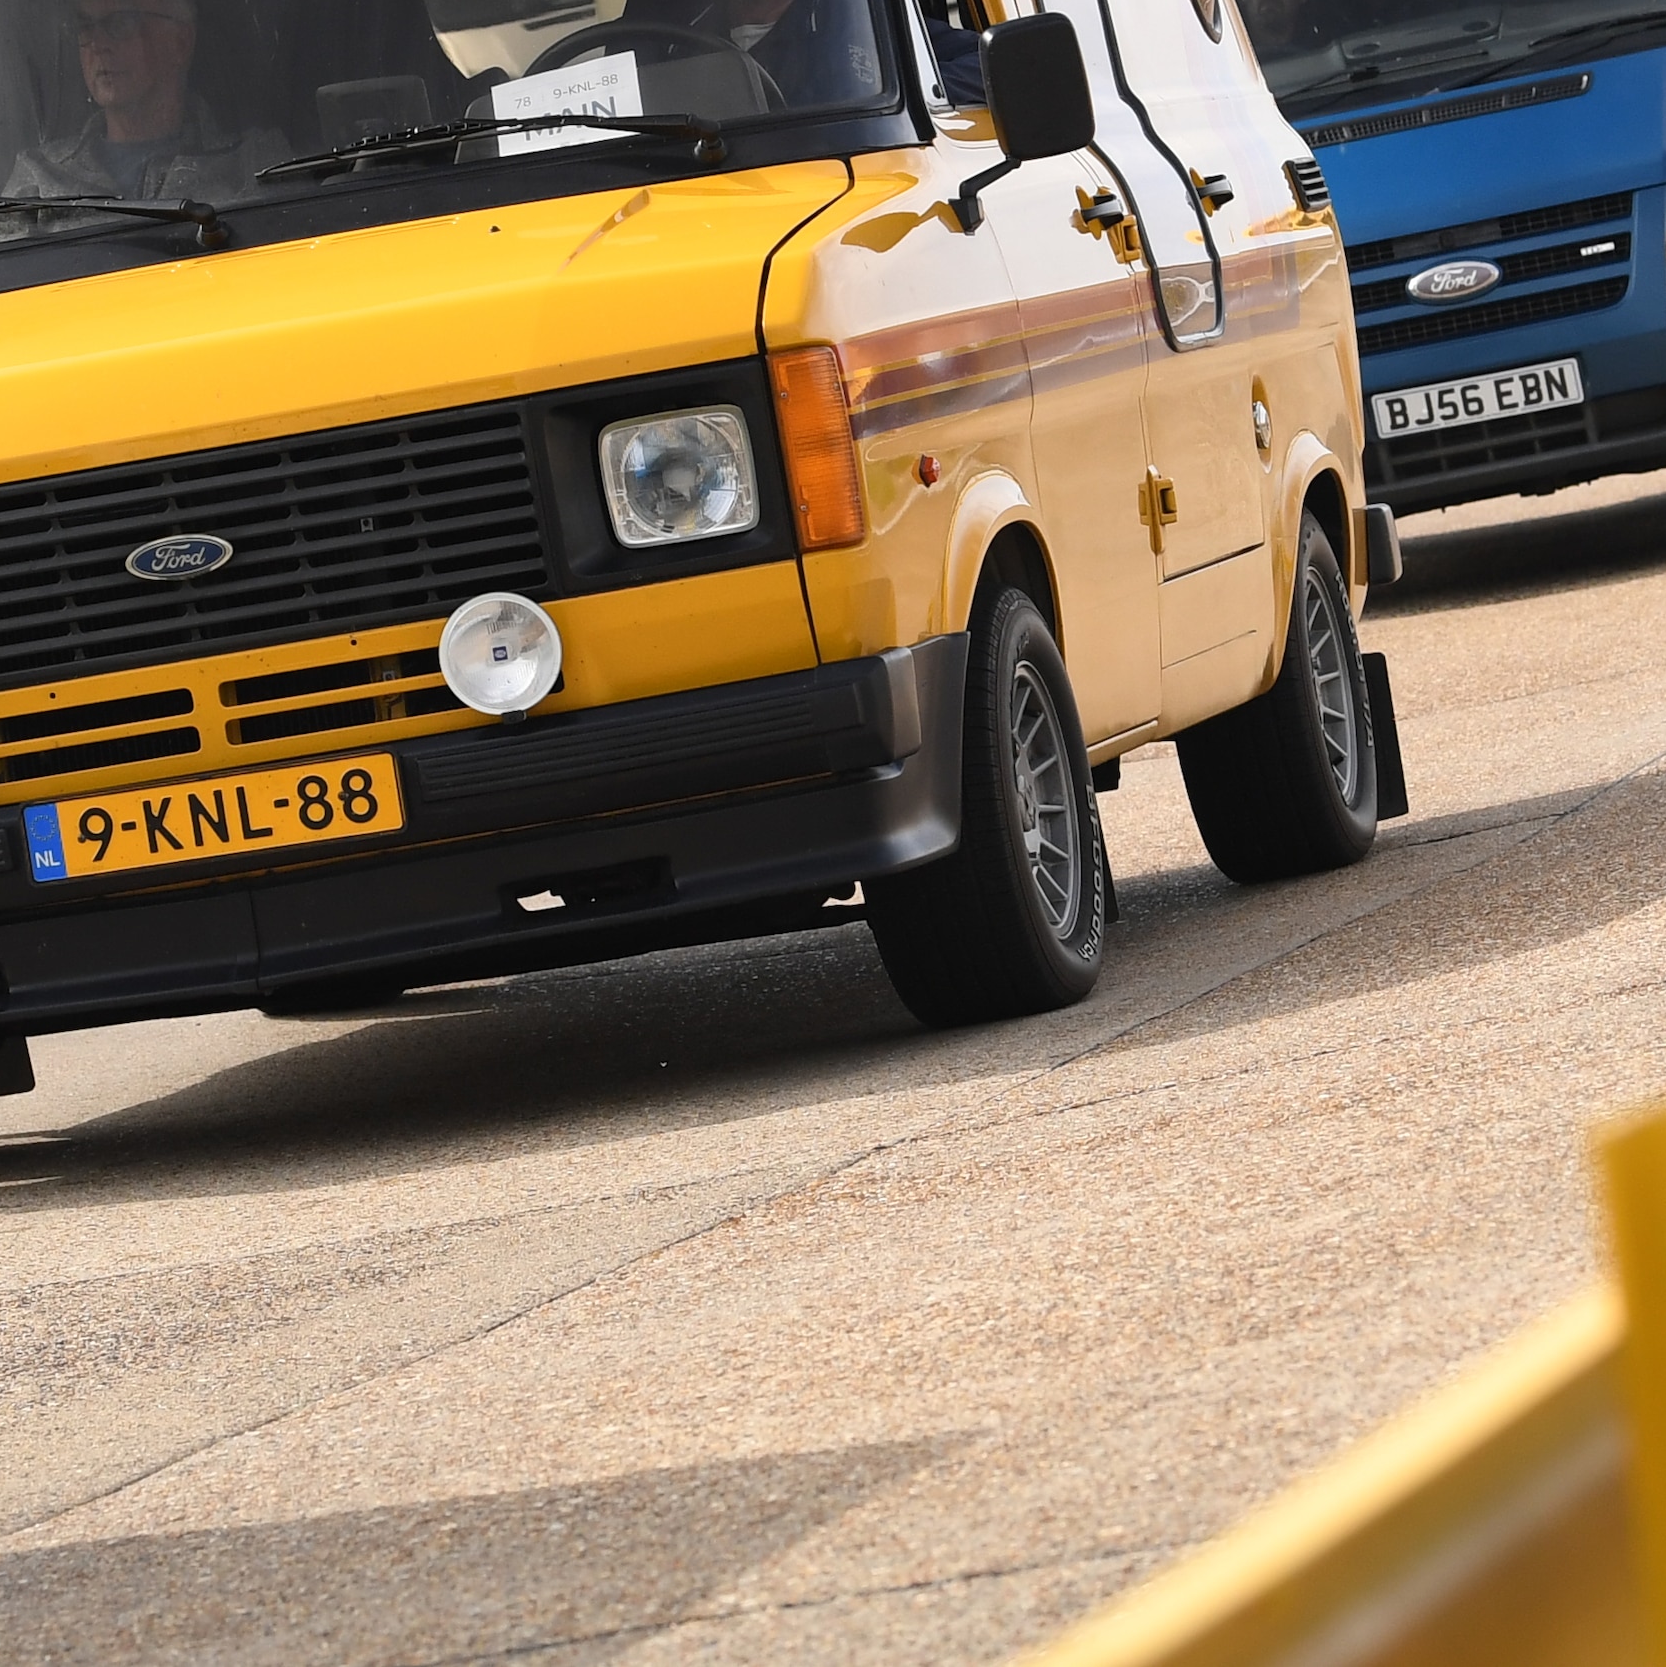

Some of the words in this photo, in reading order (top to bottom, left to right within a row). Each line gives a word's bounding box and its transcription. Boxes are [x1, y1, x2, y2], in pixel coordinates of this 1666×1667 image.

[515, 97, 531, 110] 78
[553, 74, 619, 99] 9-KNL-88
[1431, 269, 1478, 293] Ford
[1386, 385, 1485, 431] BJ56
[1494, 368, 1569, 411] EBN
[152, 544, 206, 571] Ford
[78, 768, 379, 862] 9-KNL-88
[35, 851, 61, 869] NL
